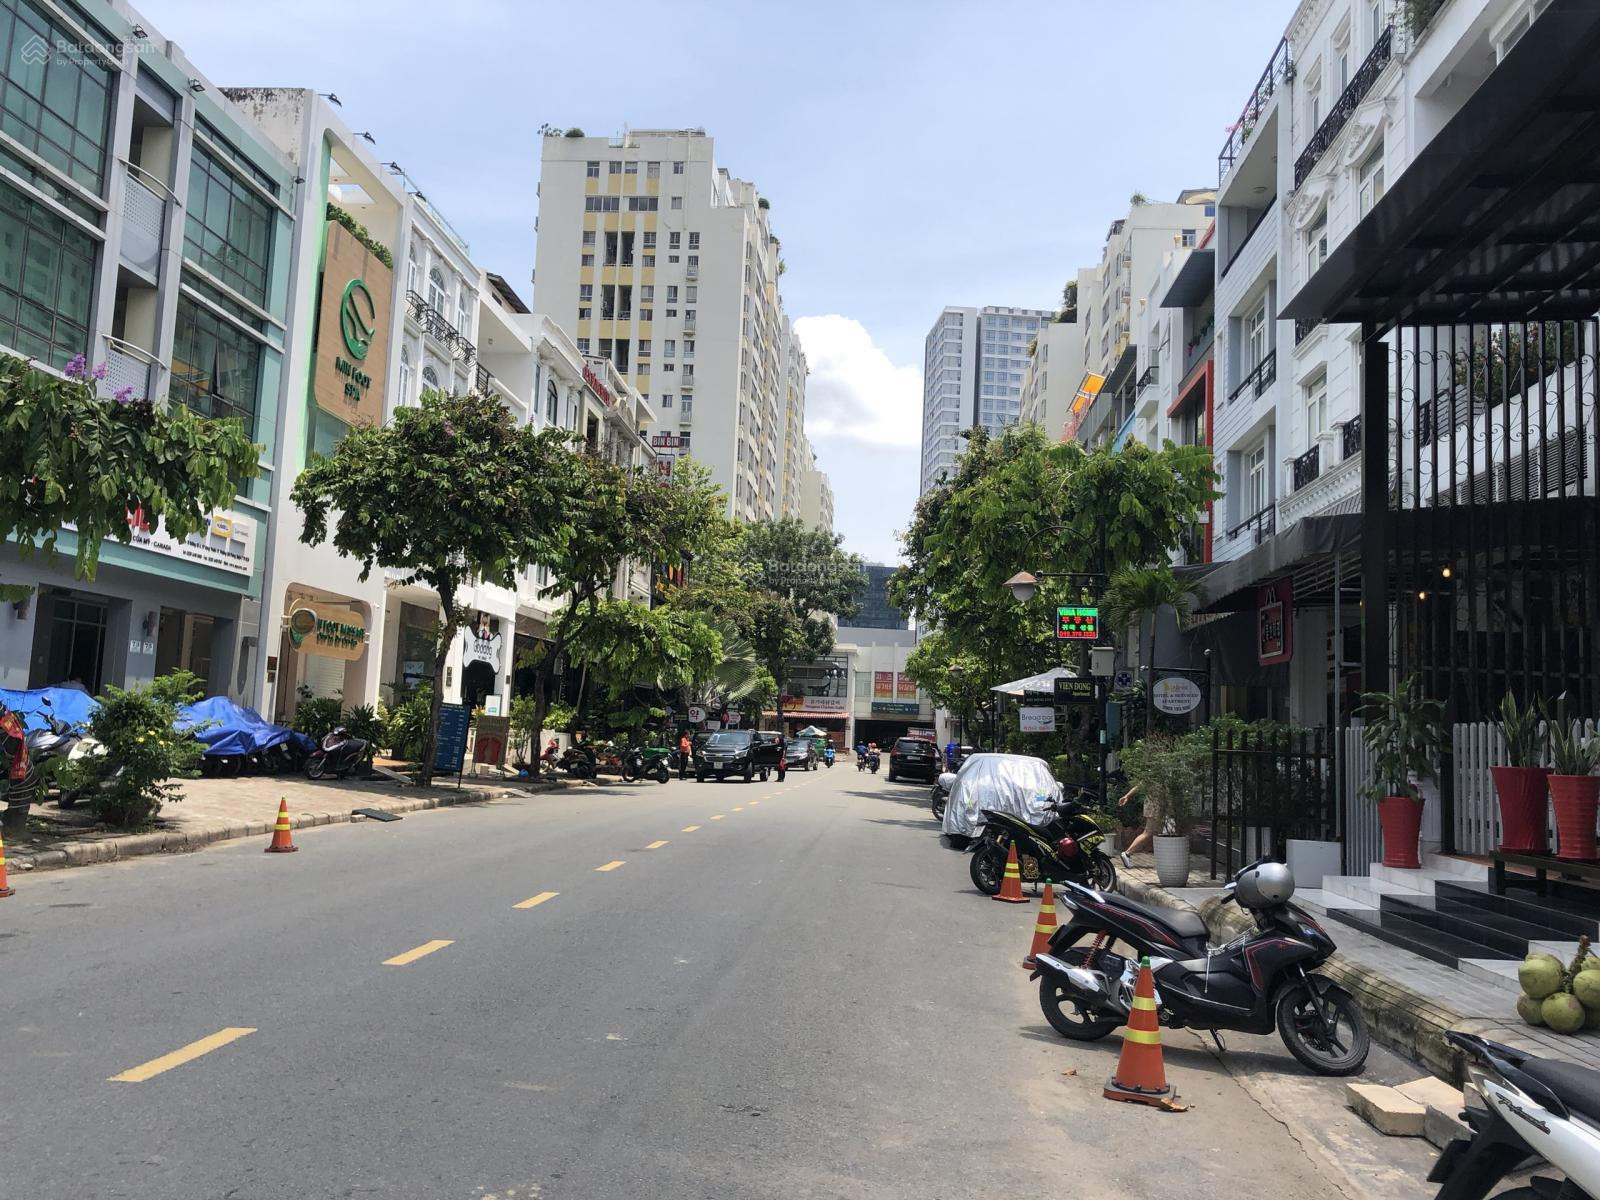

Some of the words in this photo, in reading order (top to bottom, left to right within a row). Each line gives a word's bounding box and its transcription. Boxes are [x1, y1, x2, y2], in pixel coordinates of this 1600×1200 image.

[350, 367, 372, 389] FOOT
[344, 382, 361, 401] SPA
[653, 437, 665, 446] BIN
[667, 438, 679, 447] BIN
[689, 709, 700, 720] 약
